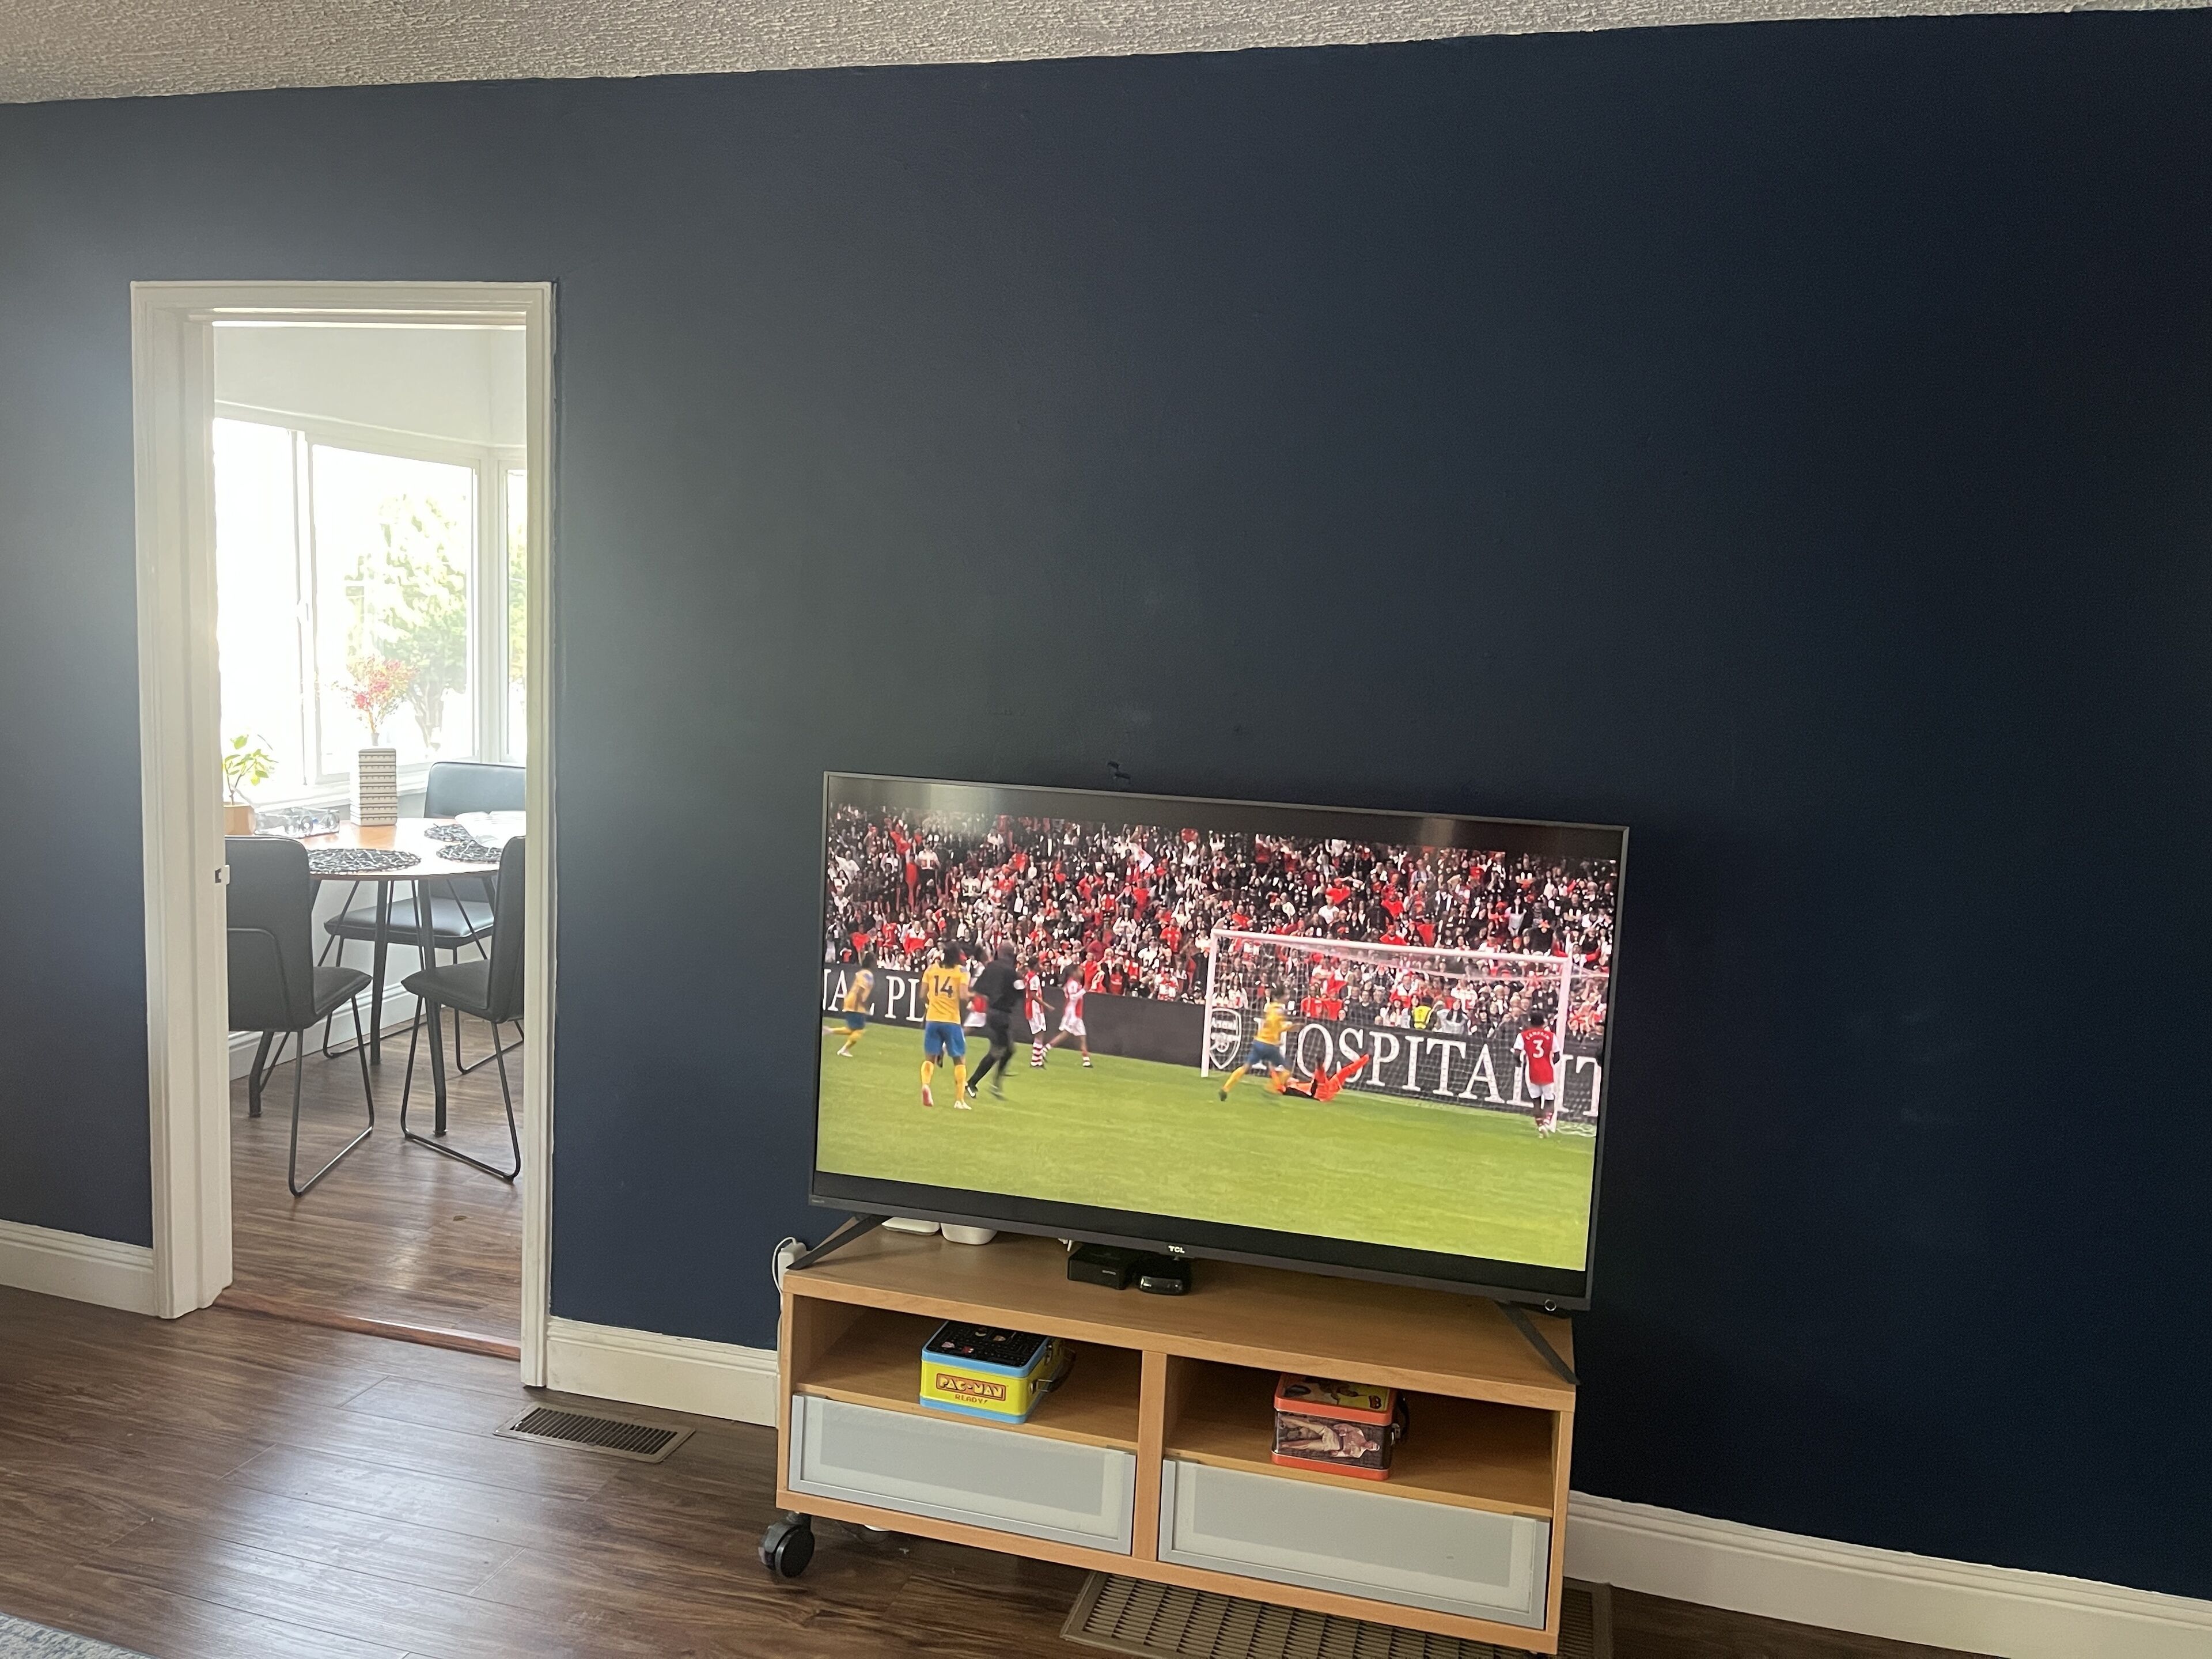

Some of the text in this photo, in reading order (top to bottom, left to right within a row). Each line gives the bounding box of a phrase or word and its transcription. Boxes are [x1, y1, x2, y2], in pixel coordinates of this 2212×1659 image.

[934, 975, 954, 998] 14
[1532, 1039, 1544, 1059] 3
[1168, 1245, 1185, 1254] TCL
[939, 1377, 1003, 1399] PAC-MAN
[955, 1393, 988, 1404] READY!
